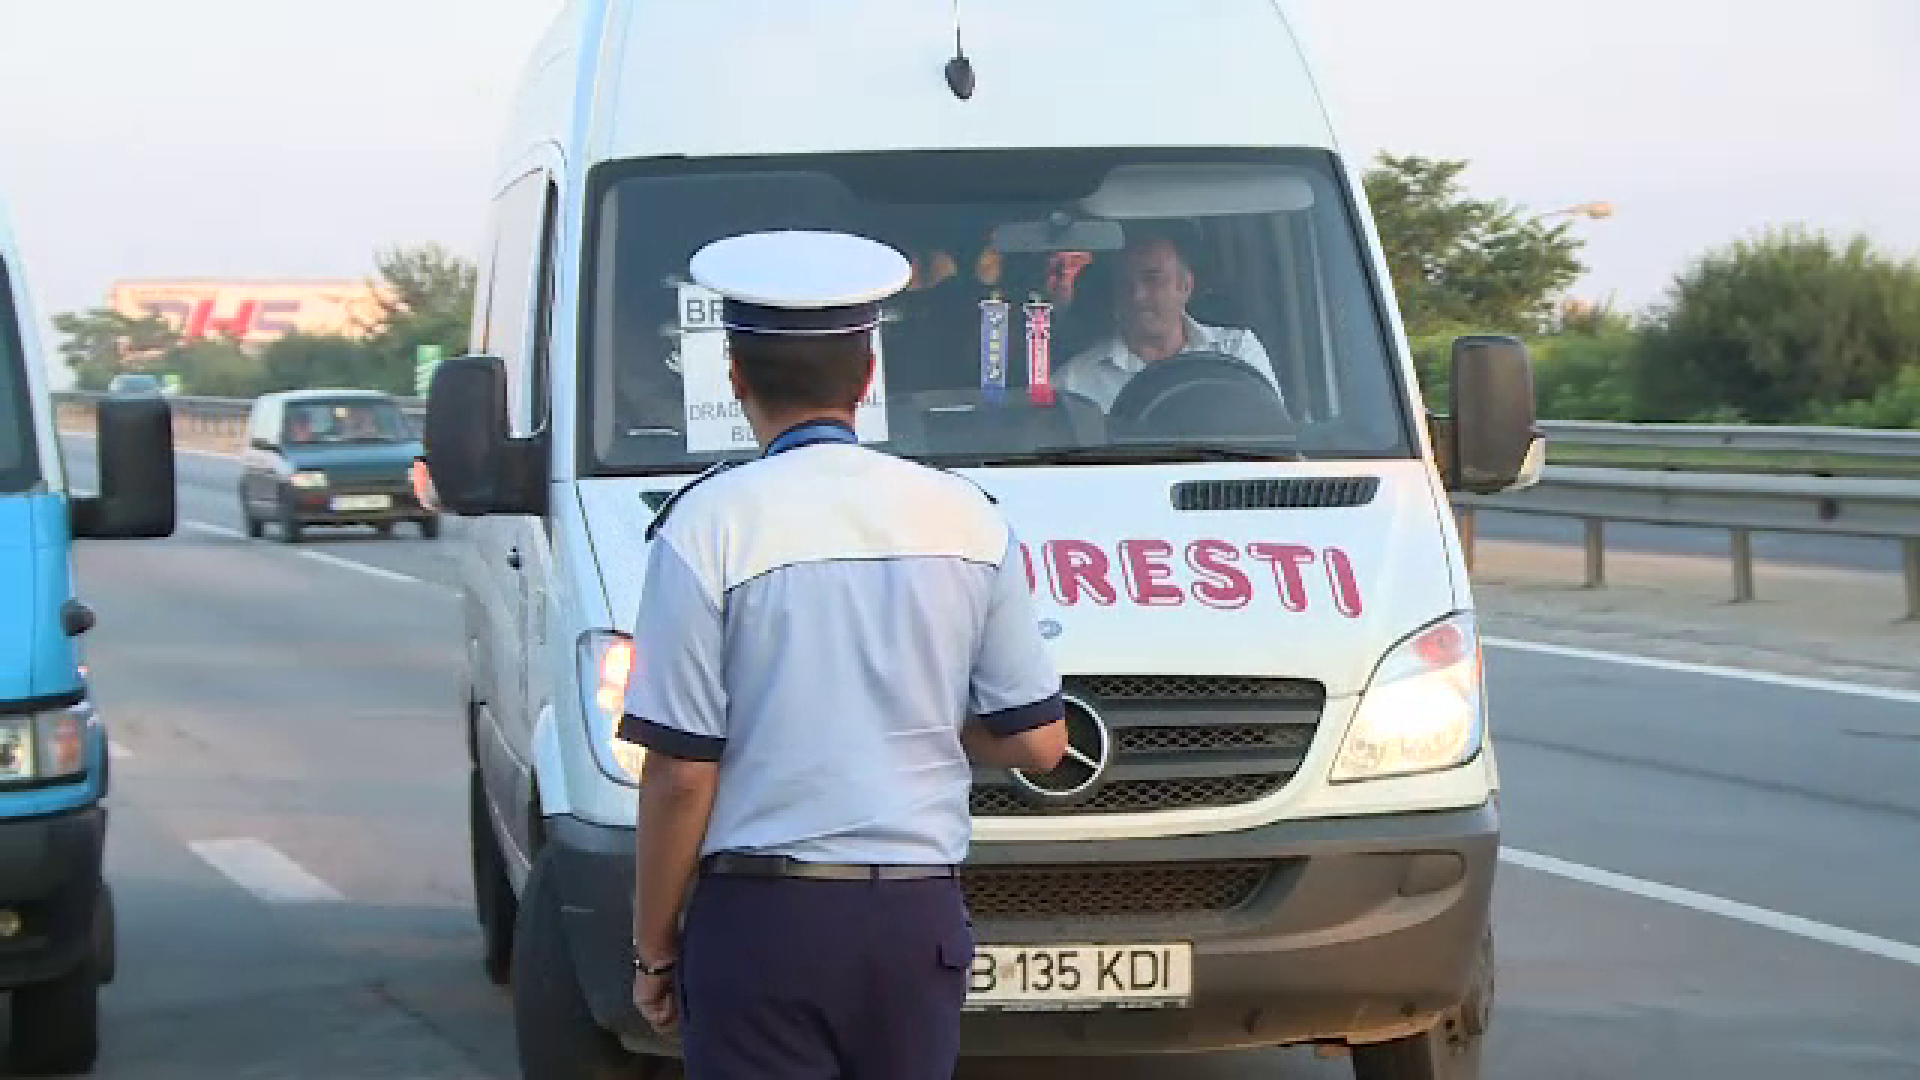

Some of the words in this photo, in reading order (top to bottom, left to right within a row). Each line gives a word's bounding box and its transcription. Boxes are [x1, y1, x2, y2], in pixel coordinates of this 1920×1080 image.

[1020, 539, 1363, 618] RESTI
[1016, 950, 1081, 993] 135
[1097, 949, 1172, 991] KDI
